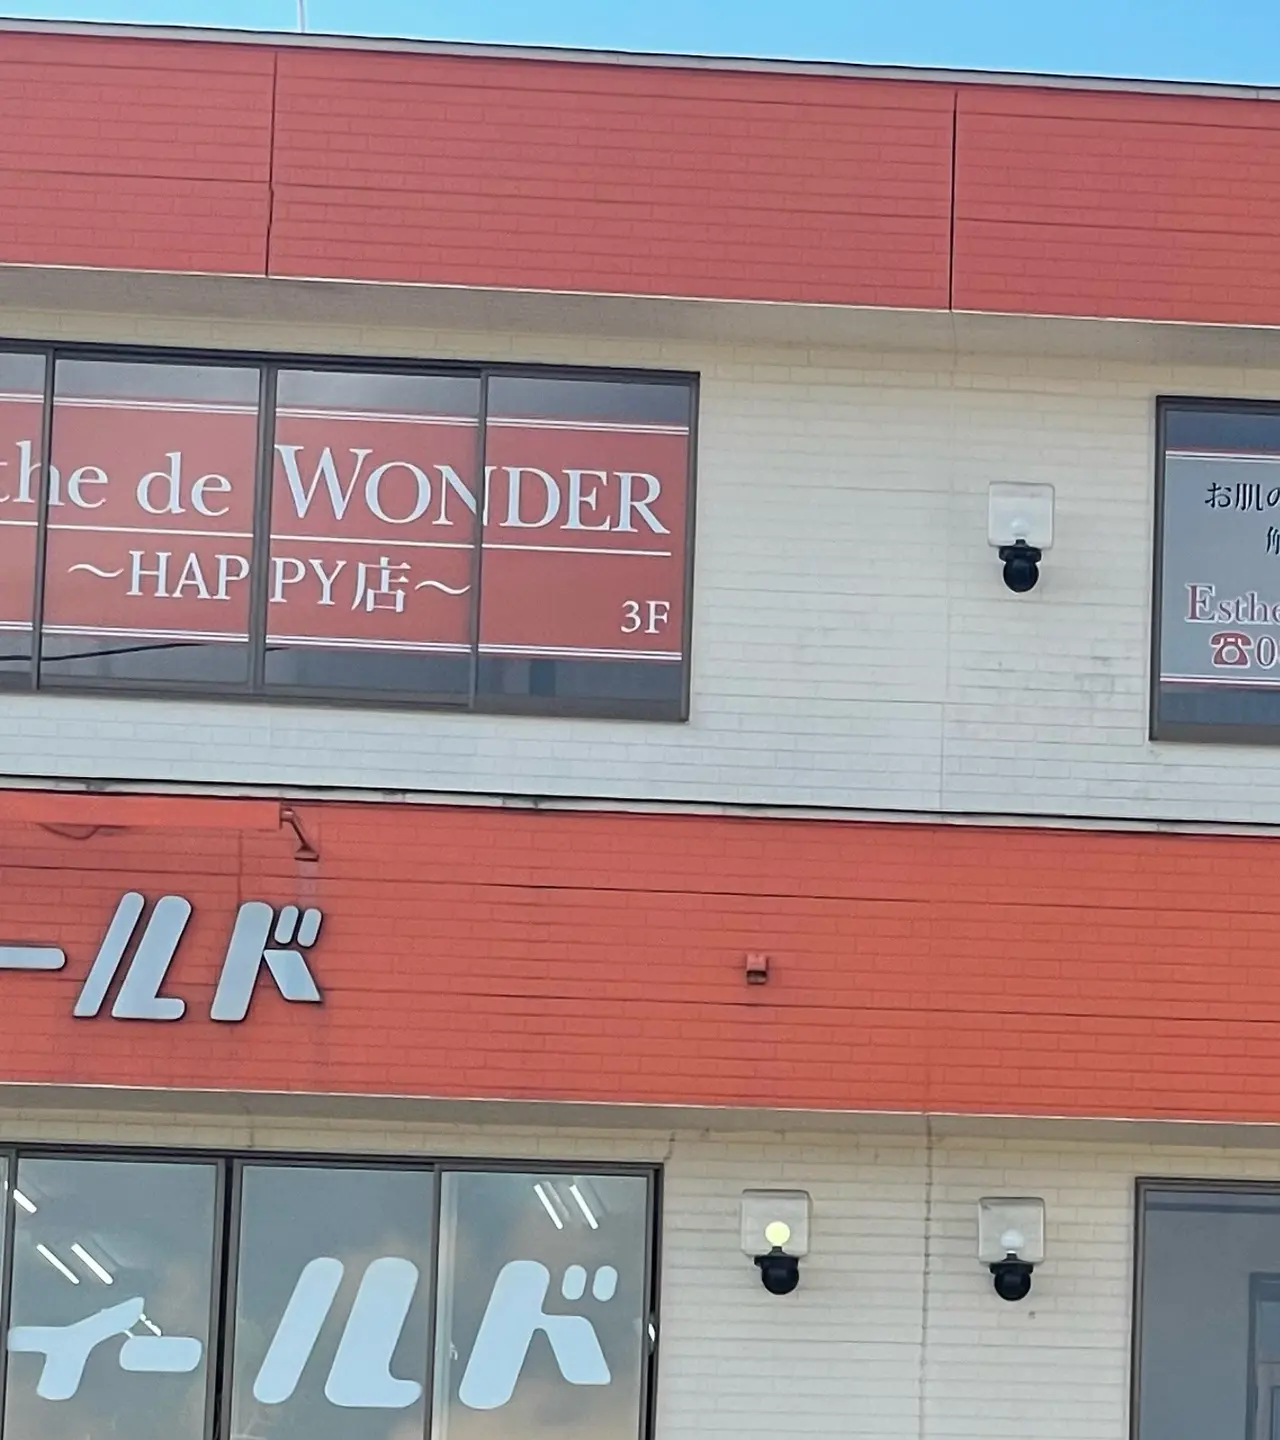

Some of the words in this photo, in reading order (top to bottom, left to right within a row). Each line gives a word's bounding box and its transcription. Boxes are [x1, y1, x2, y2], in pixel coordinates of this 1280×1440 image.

[136, 451, 232, 517] de
[275, 444, 671, 534] WONDER
[620, 600, 670, 634] 3F
